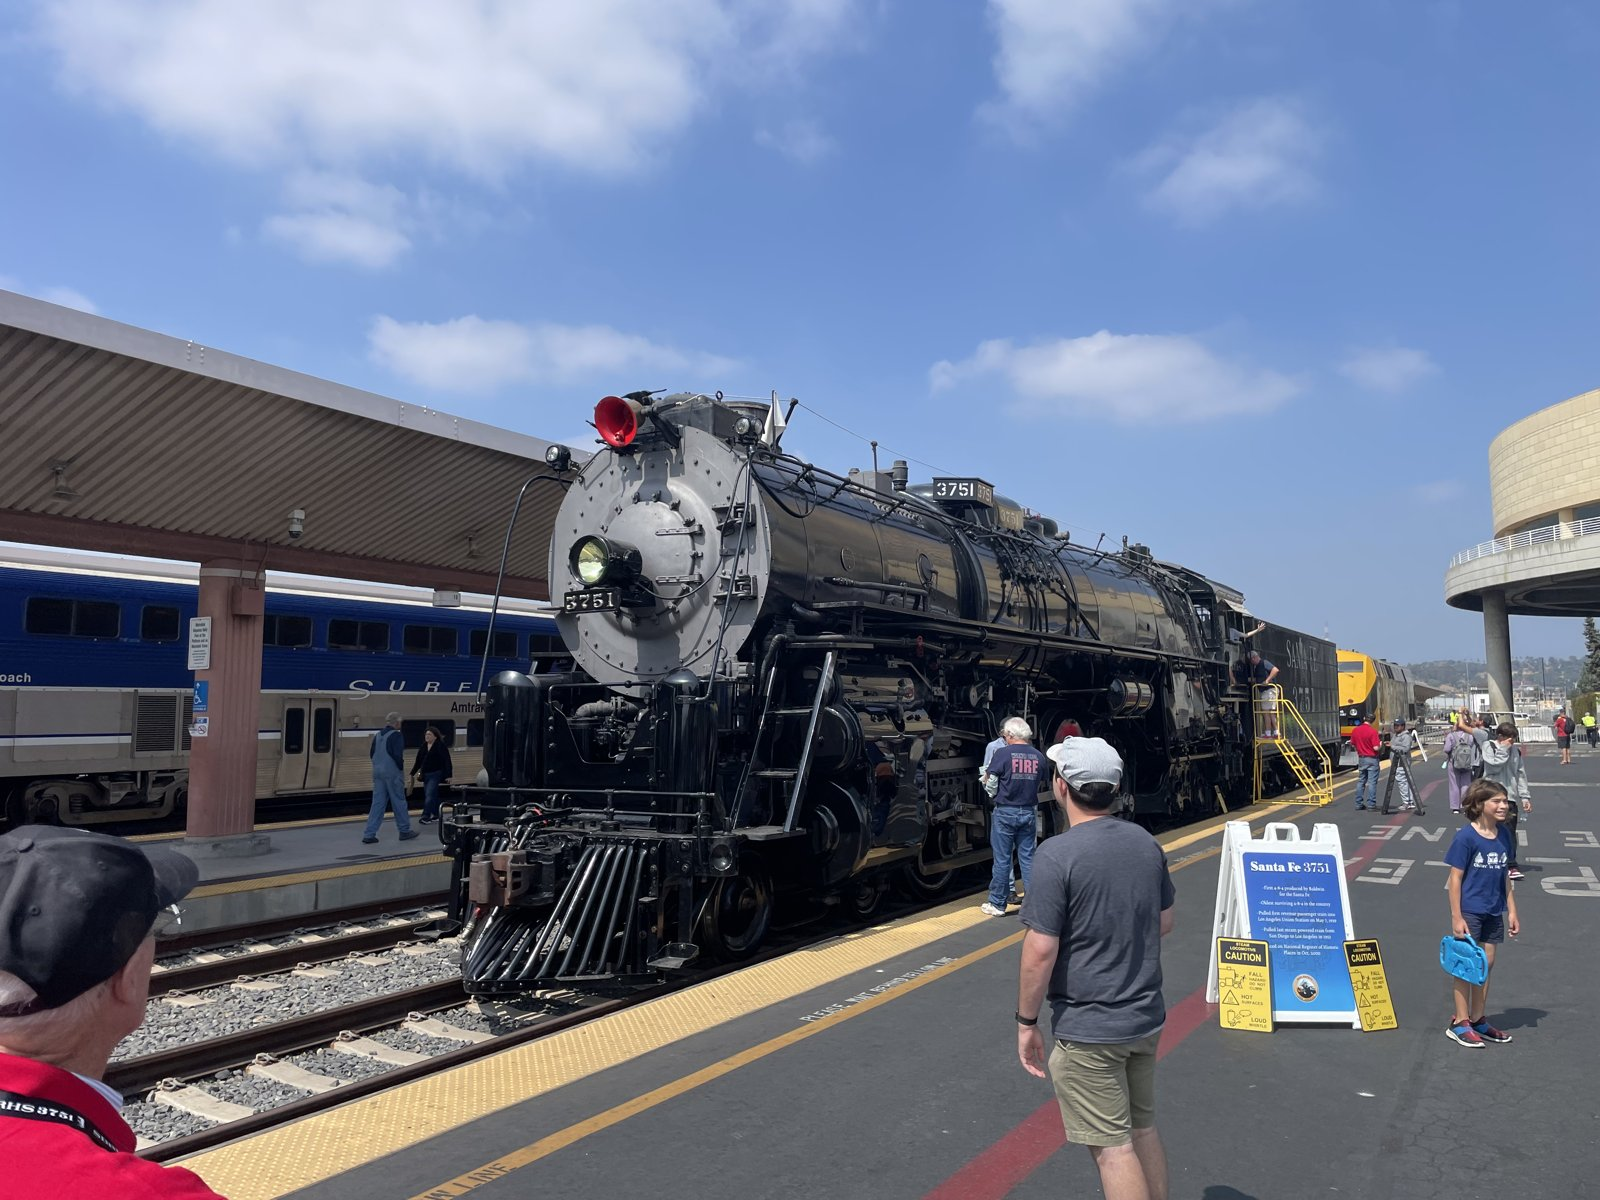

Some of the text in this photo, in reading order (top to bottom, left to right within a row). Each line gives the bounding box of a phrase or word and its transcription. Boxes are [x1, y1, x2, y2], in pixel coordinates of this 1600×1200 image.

[936, 482, 974, 497] 3751
[565, 592, 614, 610] 3751
[0, 672, 32, 683] oach
[1012, 759, 1039, 774] FIRE
[1250, 860, 1331, 874] Santa Fe 3751
[1225, 951, 1262, 962] CAUTION
[1351, 953, 1377, 962] CAUTION
[36, 1106, 74, 1121] 3751
